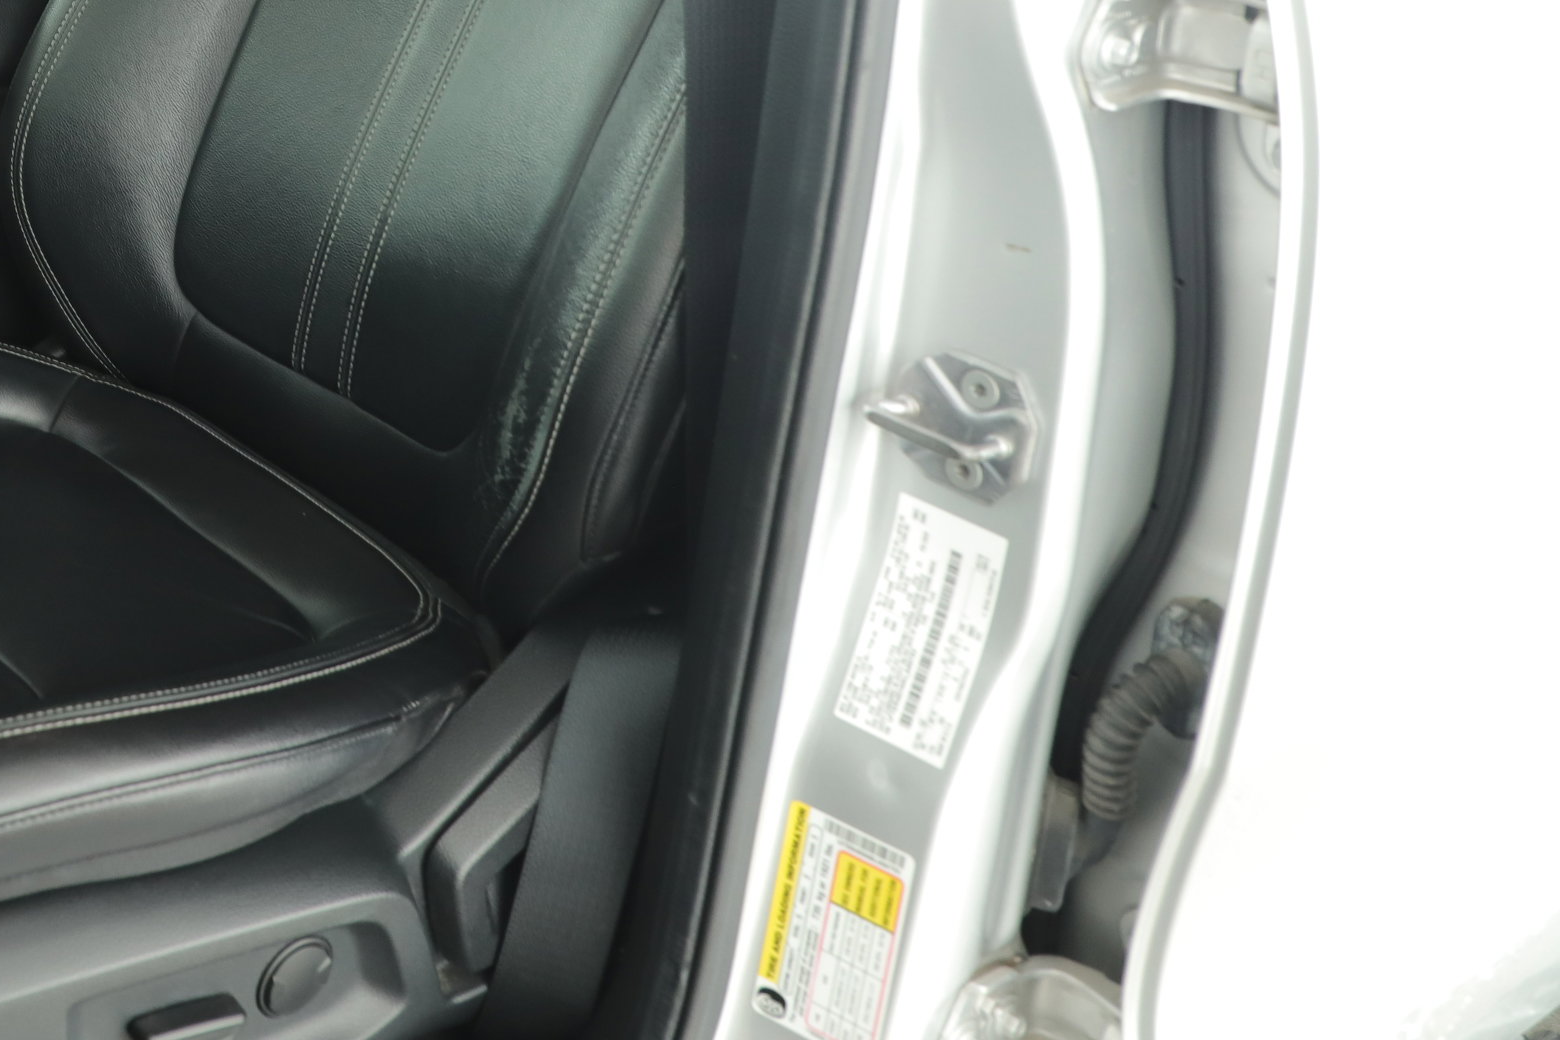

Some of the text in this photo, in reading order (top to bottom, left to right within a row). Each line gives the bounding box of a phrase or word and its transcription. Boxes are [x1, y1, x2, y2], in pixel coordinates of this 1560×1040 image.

[785, 806, 807, 881] INFORMATION
[775, 882, 792, 929] LOADING
[771, 930, 783, 954] AND
[765, 954, 778, 979] TIRE
